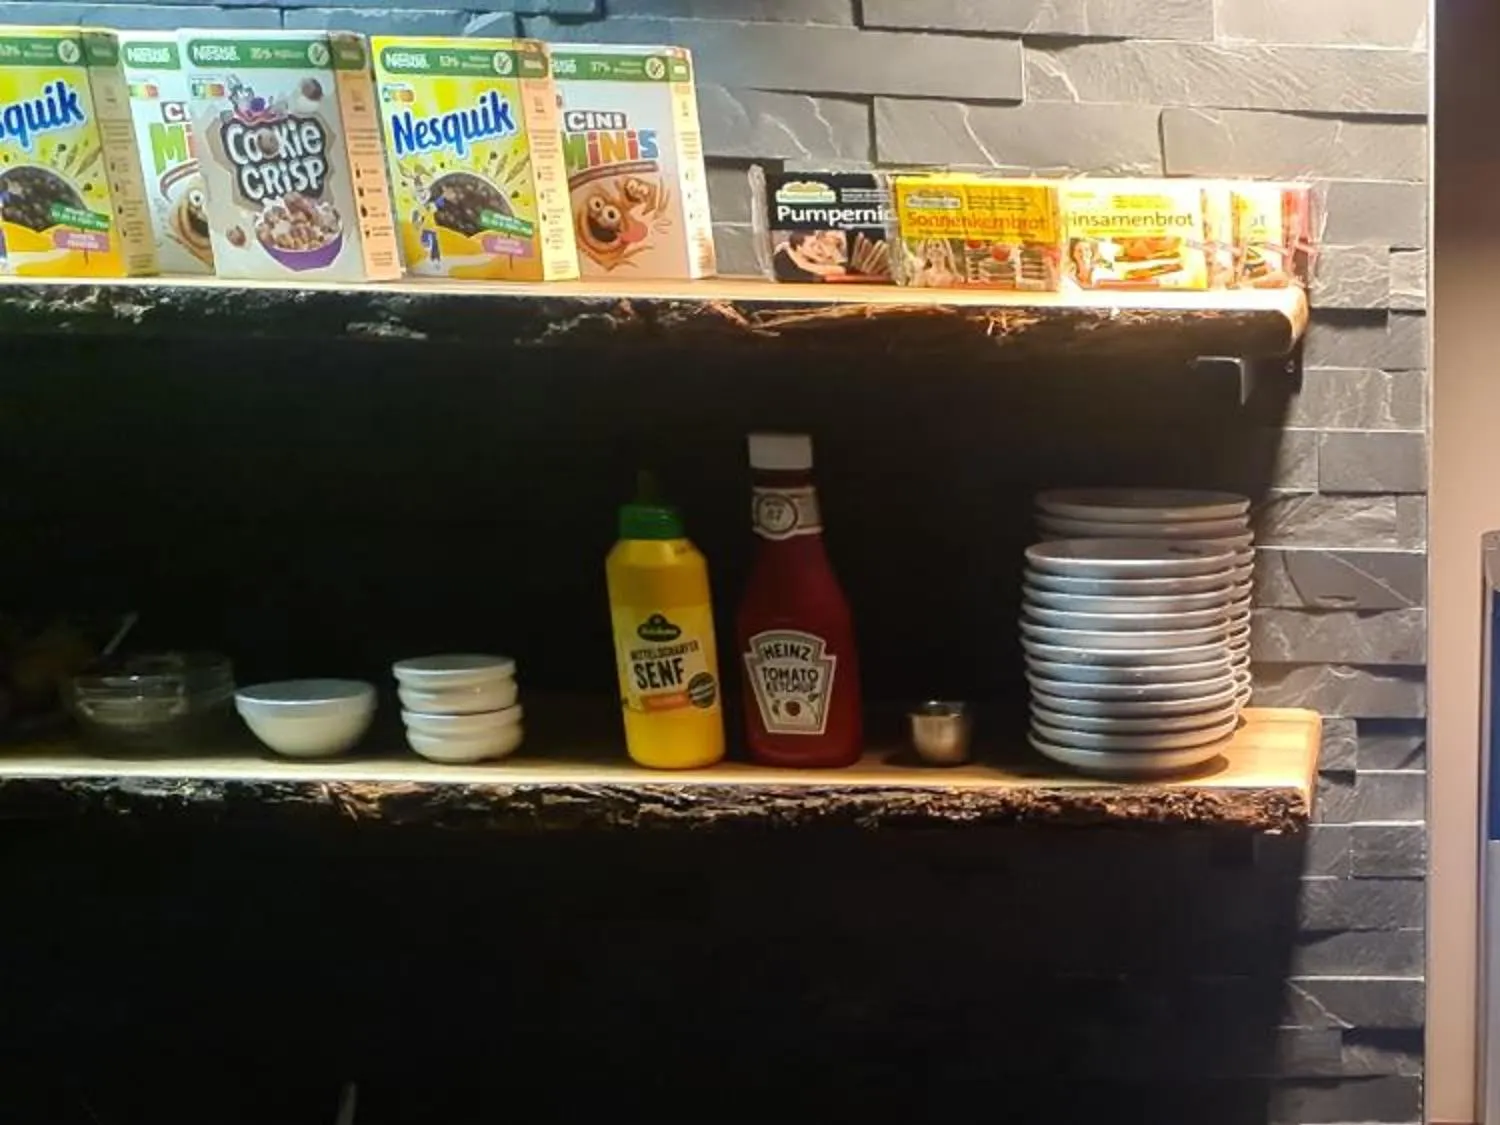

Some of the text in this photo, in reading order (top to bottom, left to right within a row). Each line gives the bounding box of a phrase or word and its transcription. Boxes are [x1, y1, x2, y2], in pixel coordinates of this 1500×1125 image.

[391, 91, 515, 155] Nesquik
[567, 112, 624, 130] CINI
[1071, 211, 1195, 228] insamenbrot
[762, 642, 813, 663] HEINZ
[633, 657, 685, 690] SENF
[762, 666, 819, 683] TOMATO
